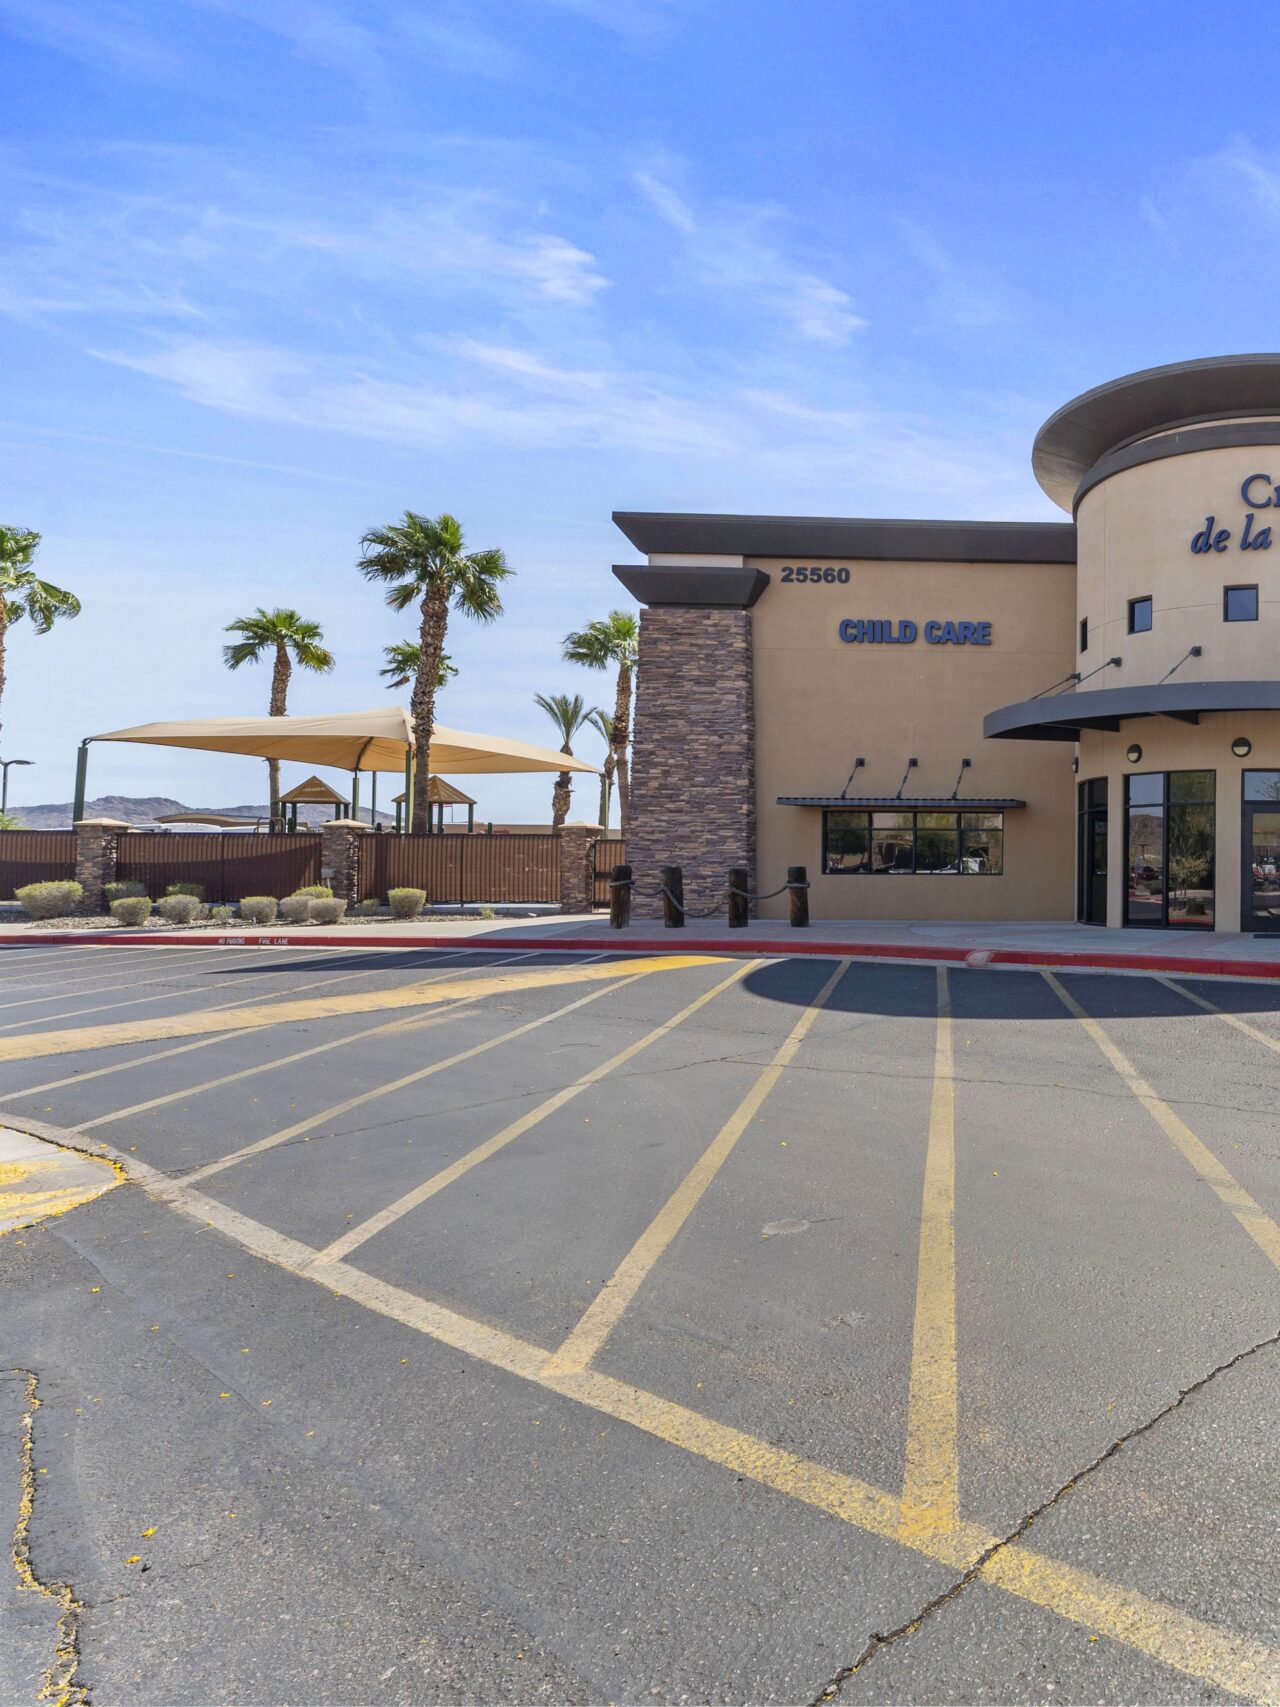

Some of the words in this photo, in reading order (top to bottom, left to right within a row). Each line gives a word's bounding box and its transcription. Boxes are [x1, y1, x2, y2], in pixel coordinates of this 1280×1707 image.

[1191, 516, 1231, 554] de
[1240, 513, 1272, 551] la
[781, 566, 850, 584] 25560
[839, 618, 917, 643] CHILD
[924, 620, 992, 645] CARE
[273, 937, 289, 945] LANE
